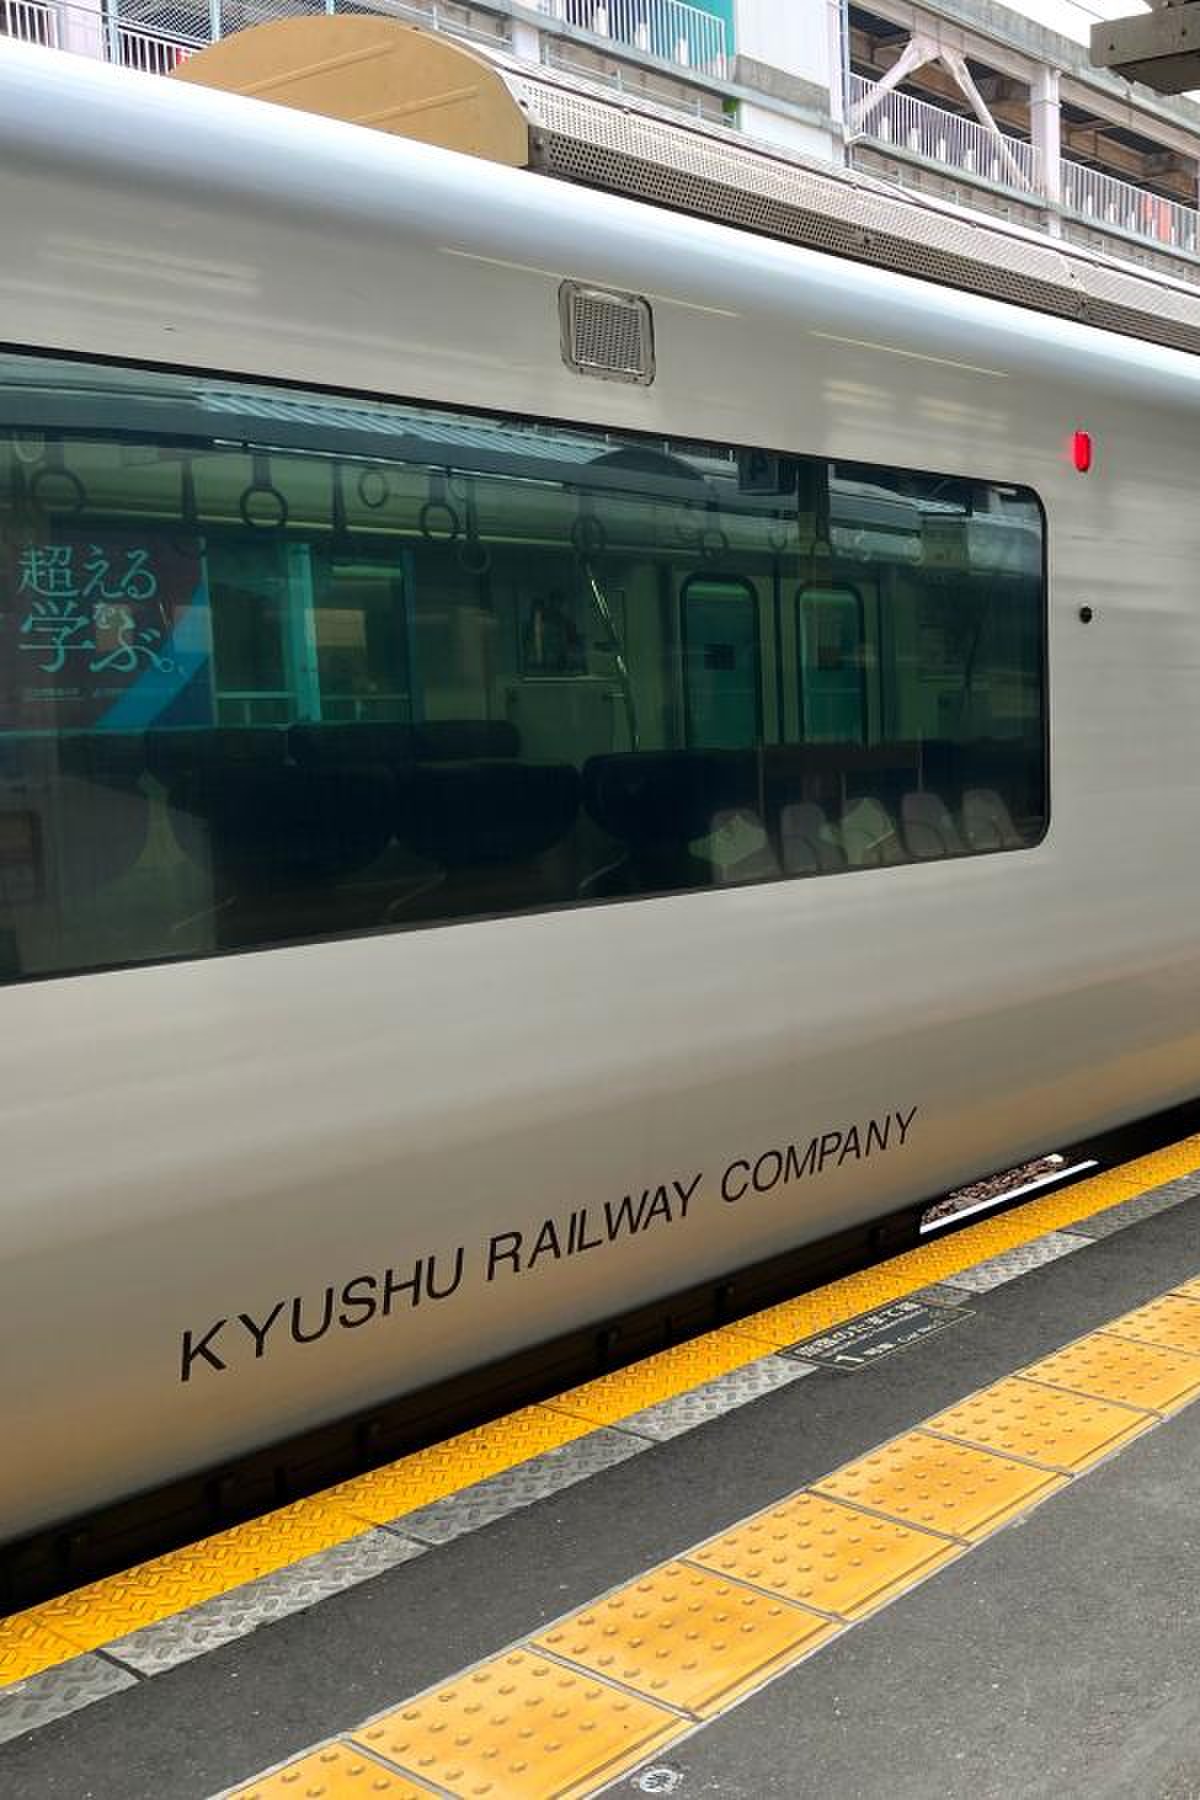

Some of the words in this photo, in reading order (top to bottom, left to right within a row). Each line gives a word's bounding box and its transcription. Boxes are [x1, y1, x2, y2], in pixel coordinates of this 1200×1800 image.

[16, 545, 157, 599] 超える
[179, 1246, 464, 1382] KYUSHU
[486, 1173, 703, 1281] RAILWAY
[720, 1106, 918, 1203] COMPANY
